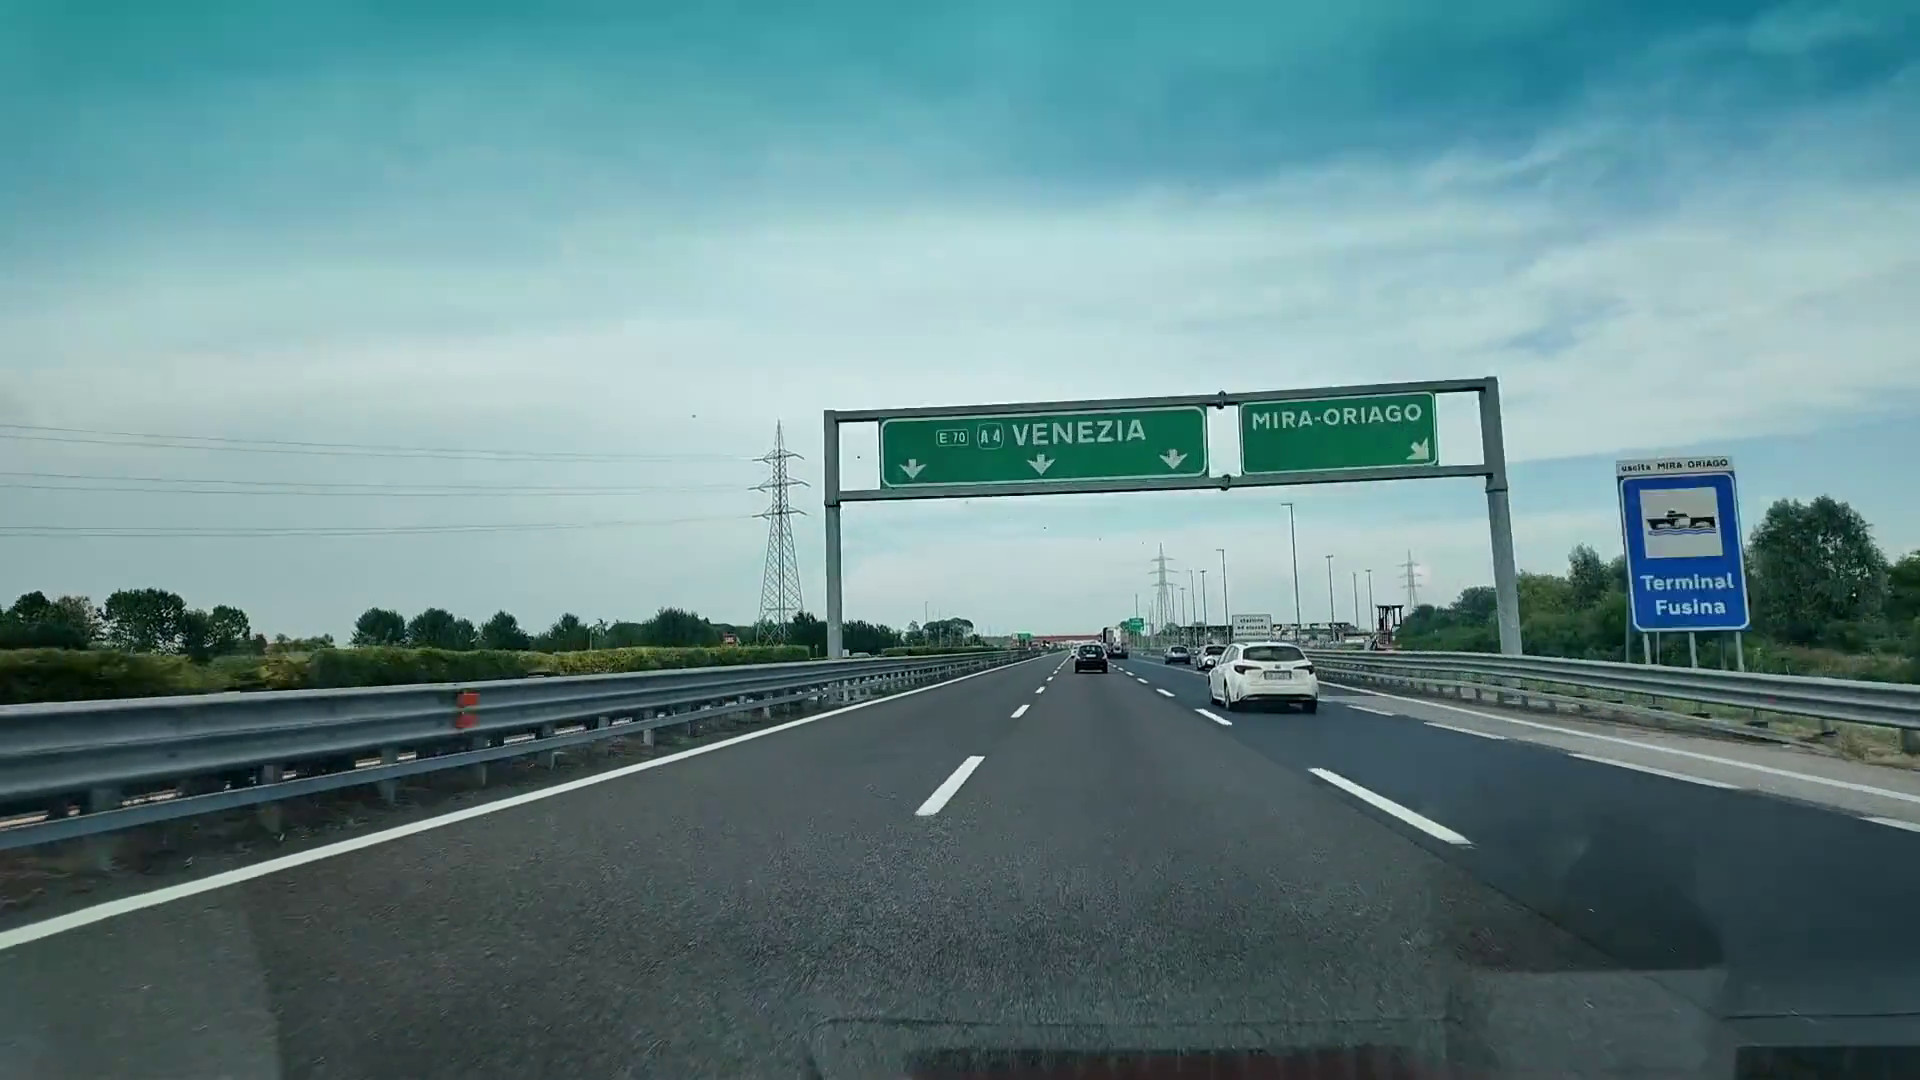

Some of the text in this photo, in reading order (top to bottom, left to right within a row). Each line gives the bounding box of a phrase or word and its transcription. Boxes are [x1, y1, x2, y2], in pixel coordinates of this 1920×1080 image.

[1252, 403, 1422, 431] MIRA-ORIAGO
[939, 419, 1146, 446] E 70 A 4 VENEZIA
[1621, 459, 1728, 472] uscita MIRA ORIAGO
[1640, 572, 1734, 591] Terminal
[1655, 599, 1726, 616] Fusina
